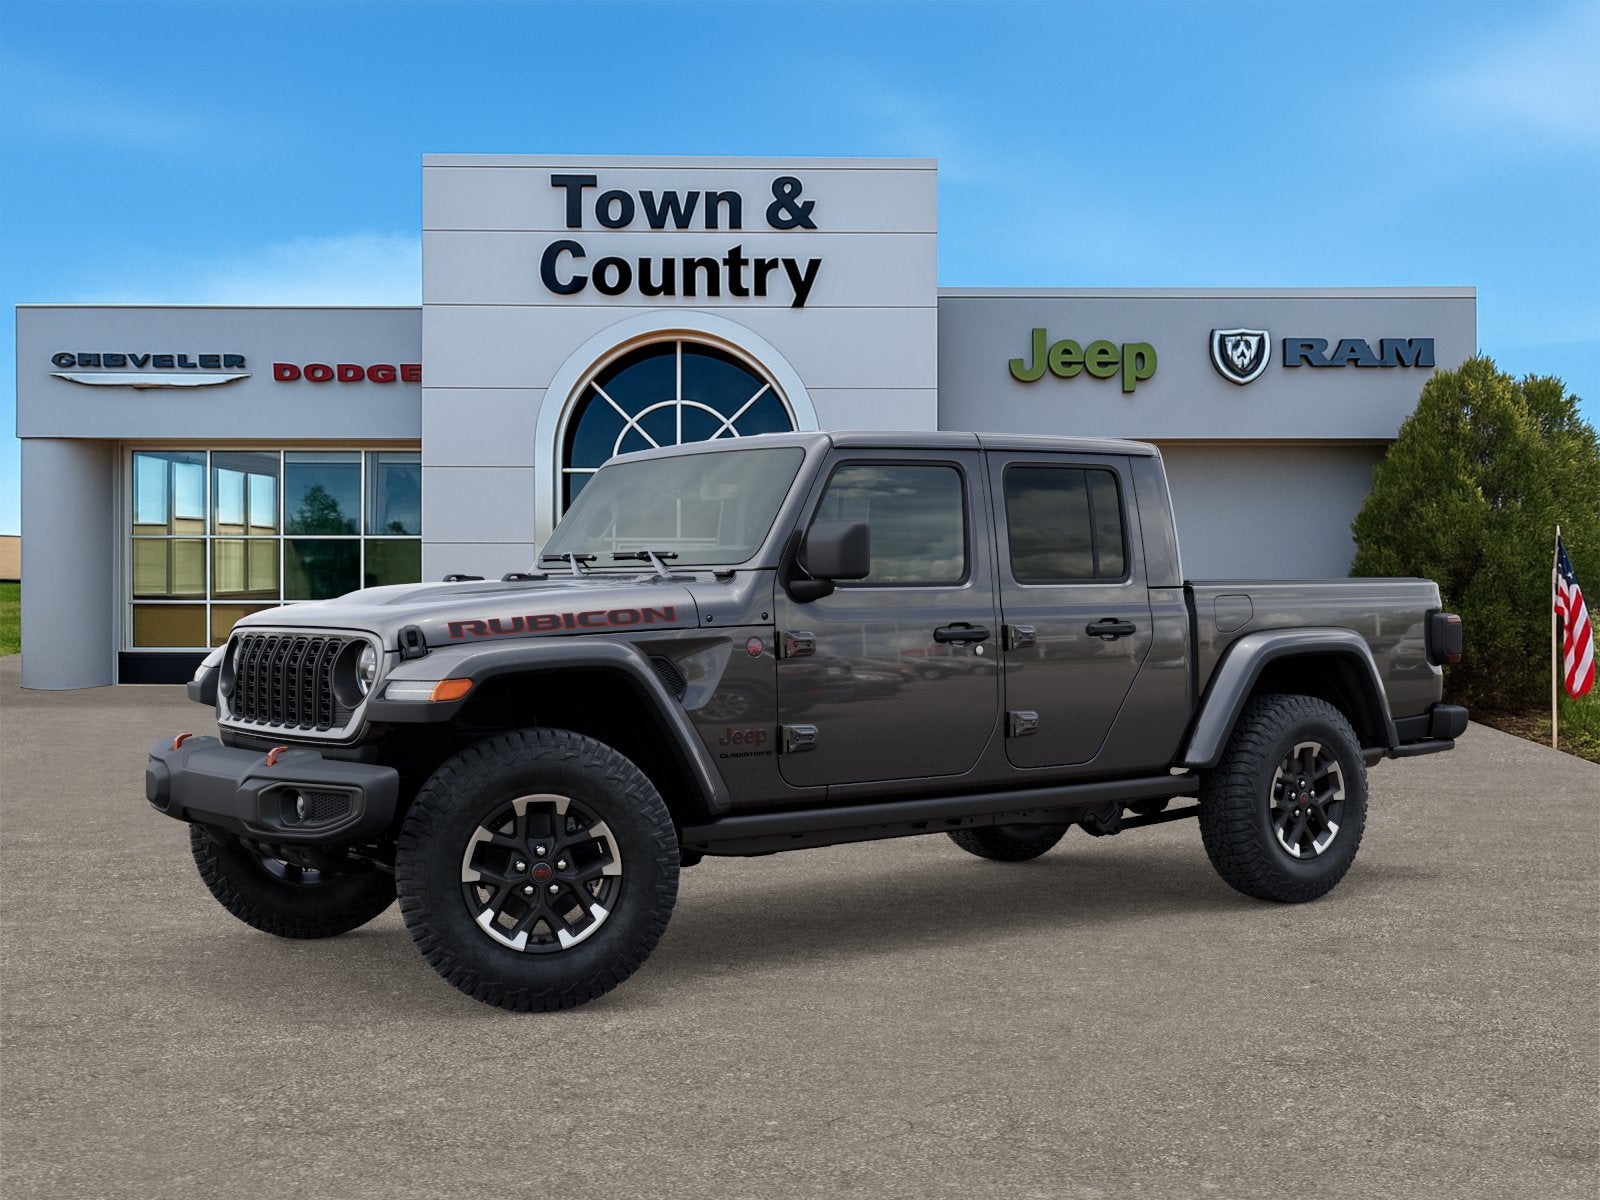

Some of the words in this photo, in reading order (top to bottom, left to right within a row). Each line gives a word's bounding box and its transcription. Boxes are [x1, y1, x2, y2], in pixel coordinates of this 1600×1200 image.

[550, 174, 743, 230] Town
[765, 175, 818, 230] &
[539, 239, 823, 308] Country
[1008, 327, 1158, 393] Jeep
[1282, 337, 1436, 368] RAM
[273, 362, 422, 383] DODGE
[447, 606, 677, 639] RUBICON
[718, 726, 768, 747] Jeep
